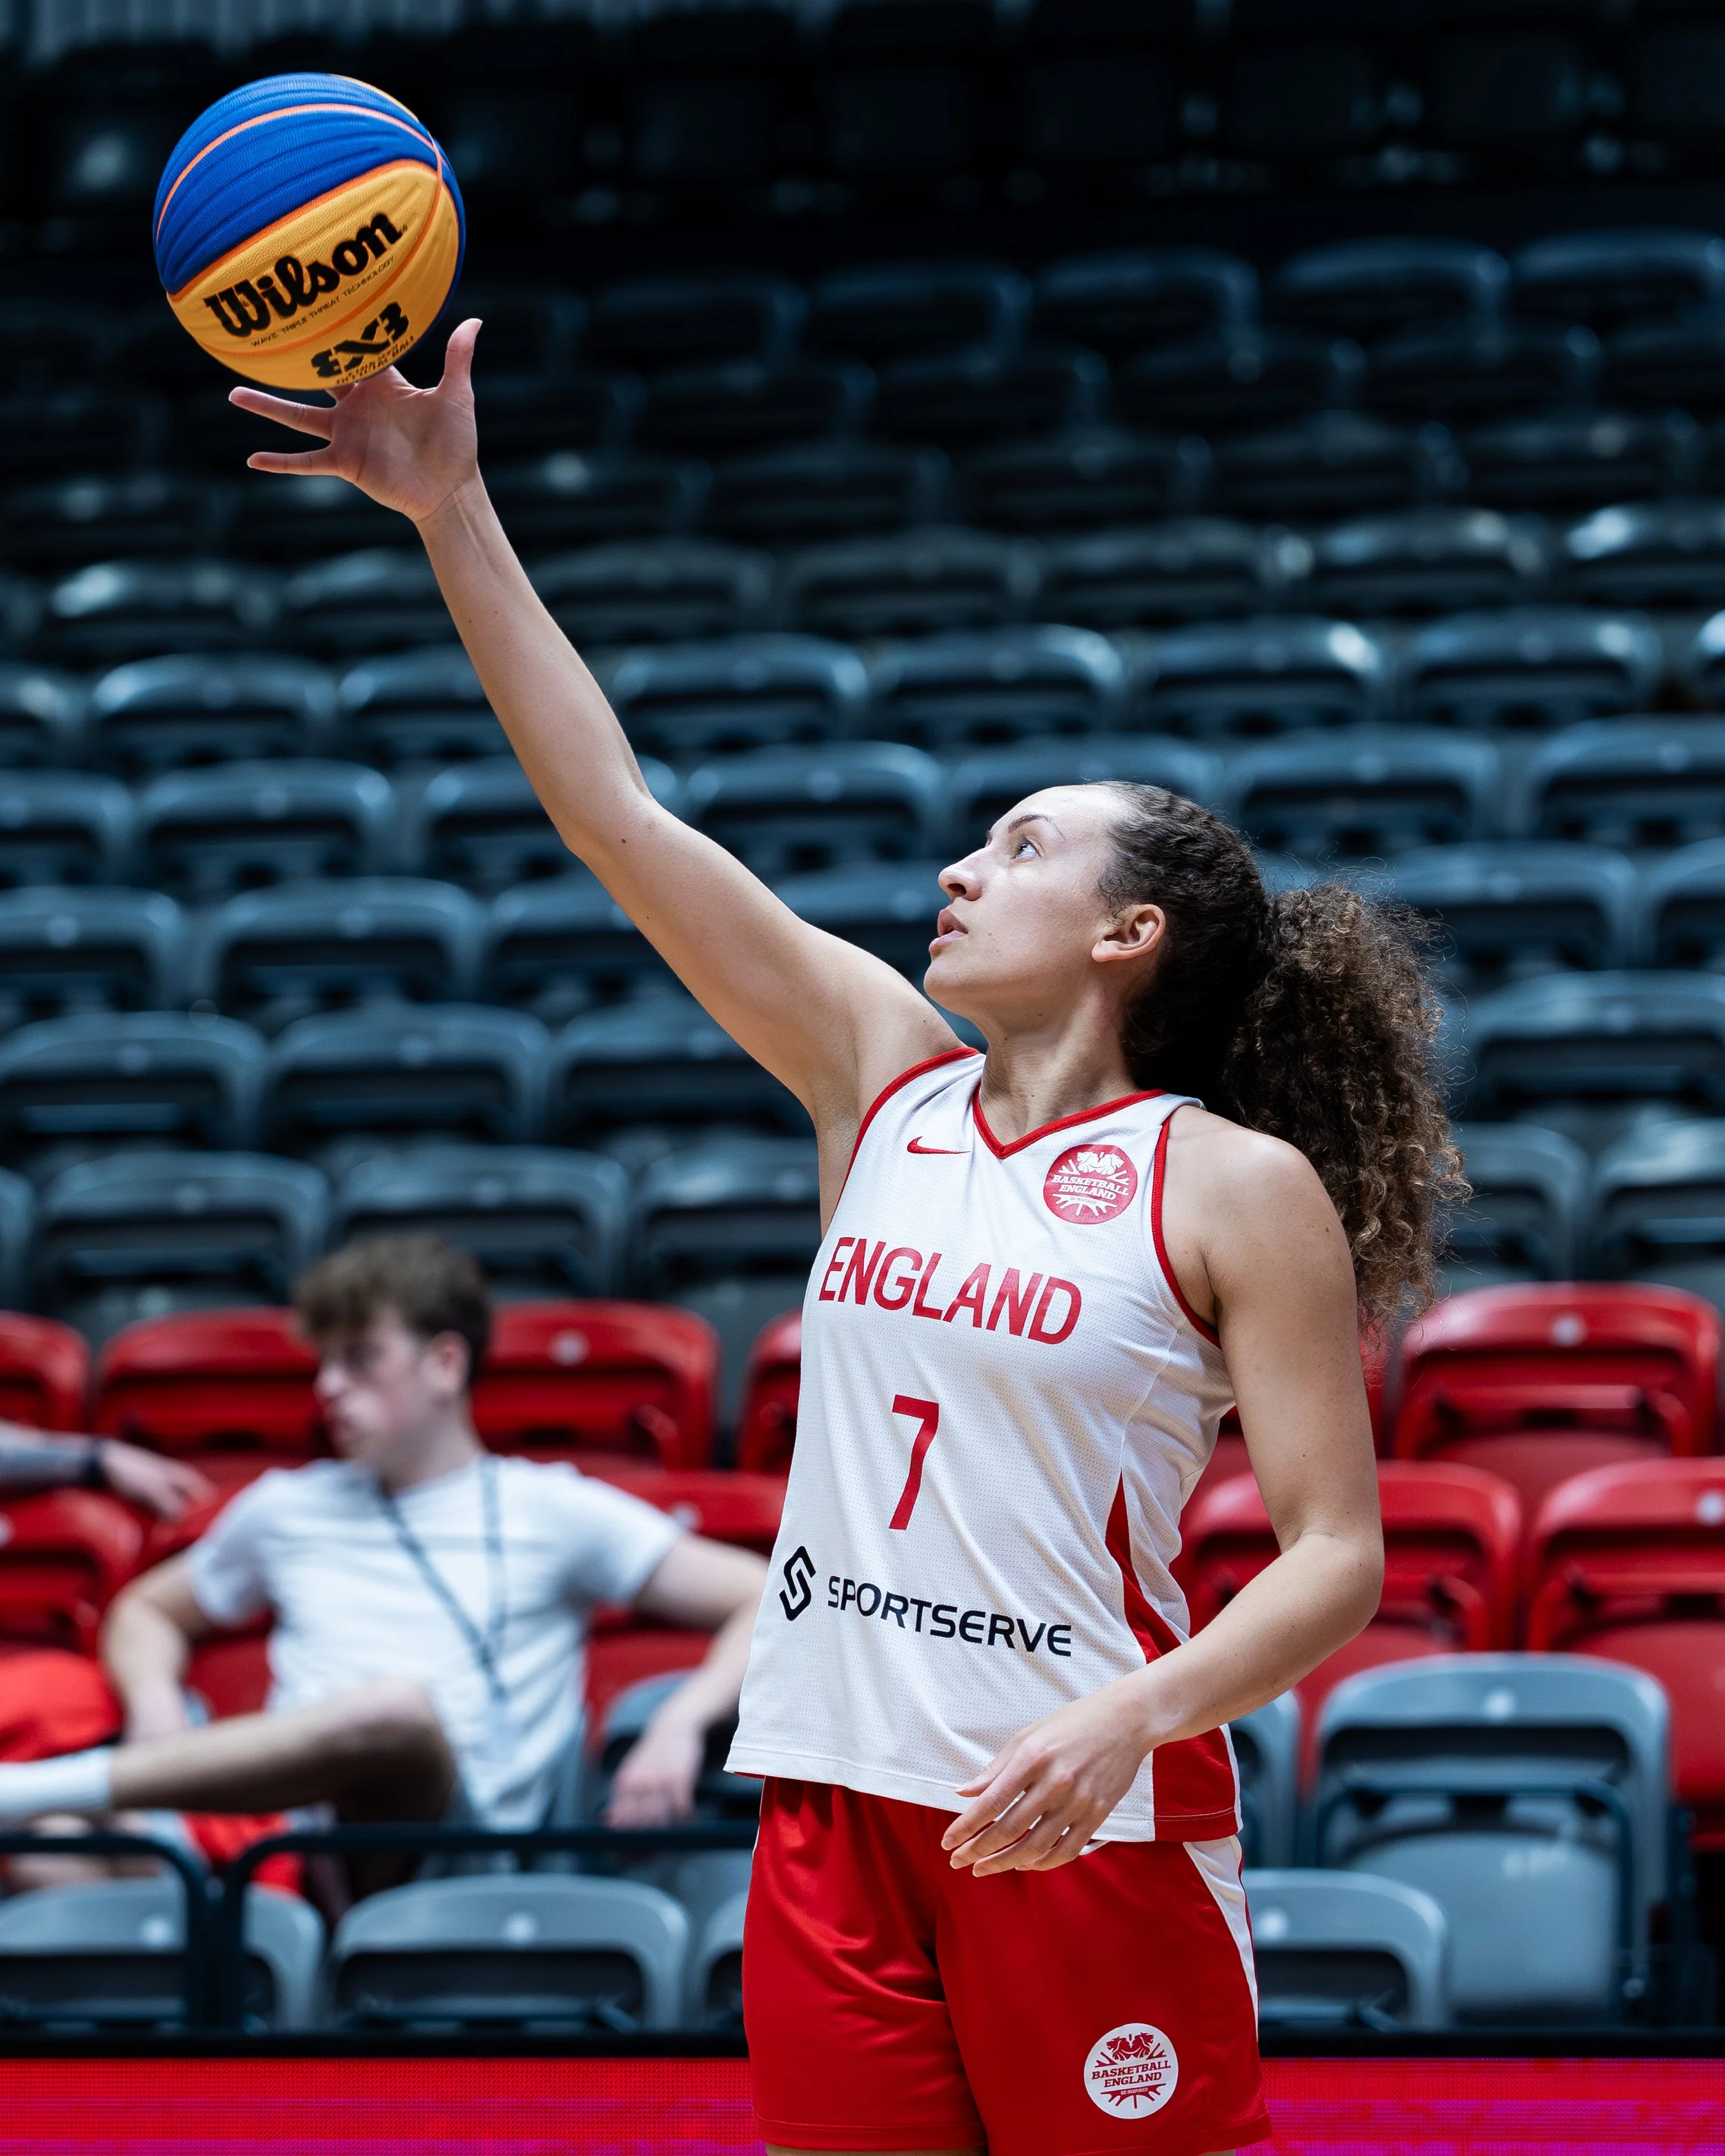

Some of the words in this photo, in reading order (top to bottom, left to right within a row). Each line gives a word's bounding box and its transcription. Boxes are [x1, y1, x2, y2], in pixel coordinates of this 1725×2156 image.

[202, 213, 402, 337] Wilson
[1052, 1174, 1130, 1196] BASKETBALL
[1058, 1184, 1117, 1200] ENGLAND
[818, 1236, 1082, 1345] ENGLAND
[889, 1394, 939, 1530] 7
[828, 1575, 1072, 1656] SPORTSERVE
[1092, 2060, 1172, 2080] BASKETBALL
[1104, 2072, 1162, 2088] ENGLAND
